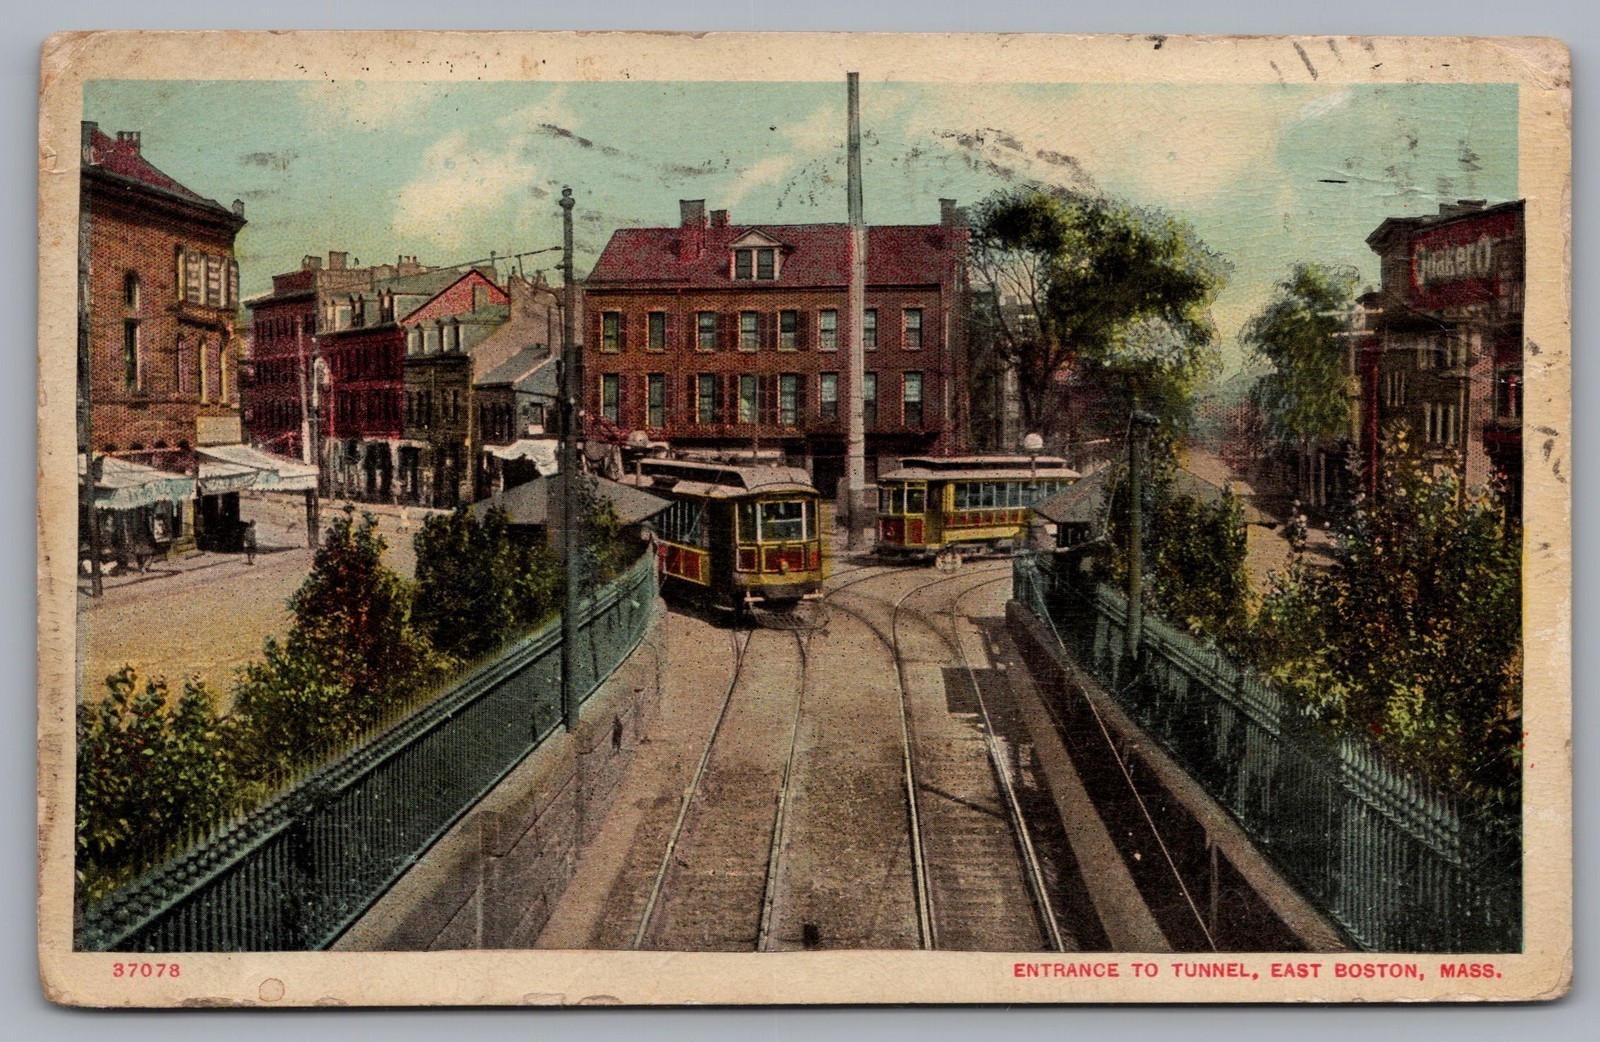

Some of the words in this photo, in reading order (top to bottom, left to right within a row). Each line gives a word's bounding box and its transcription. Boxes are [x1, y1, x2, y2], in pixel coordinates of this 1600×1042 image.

[111, 961, 181, 979] 37078
[1013, 961, 1121, 979] ENTRANCE
[1130, 961, 1160, 979] TO
[1172, 961, 1260, 981] TUNNEL,
[1270, 961, 1323, 979] EAST
[1334, 961, 1426, 982] BOSTON,
[1439, 961, 1504, 979] MASS.
